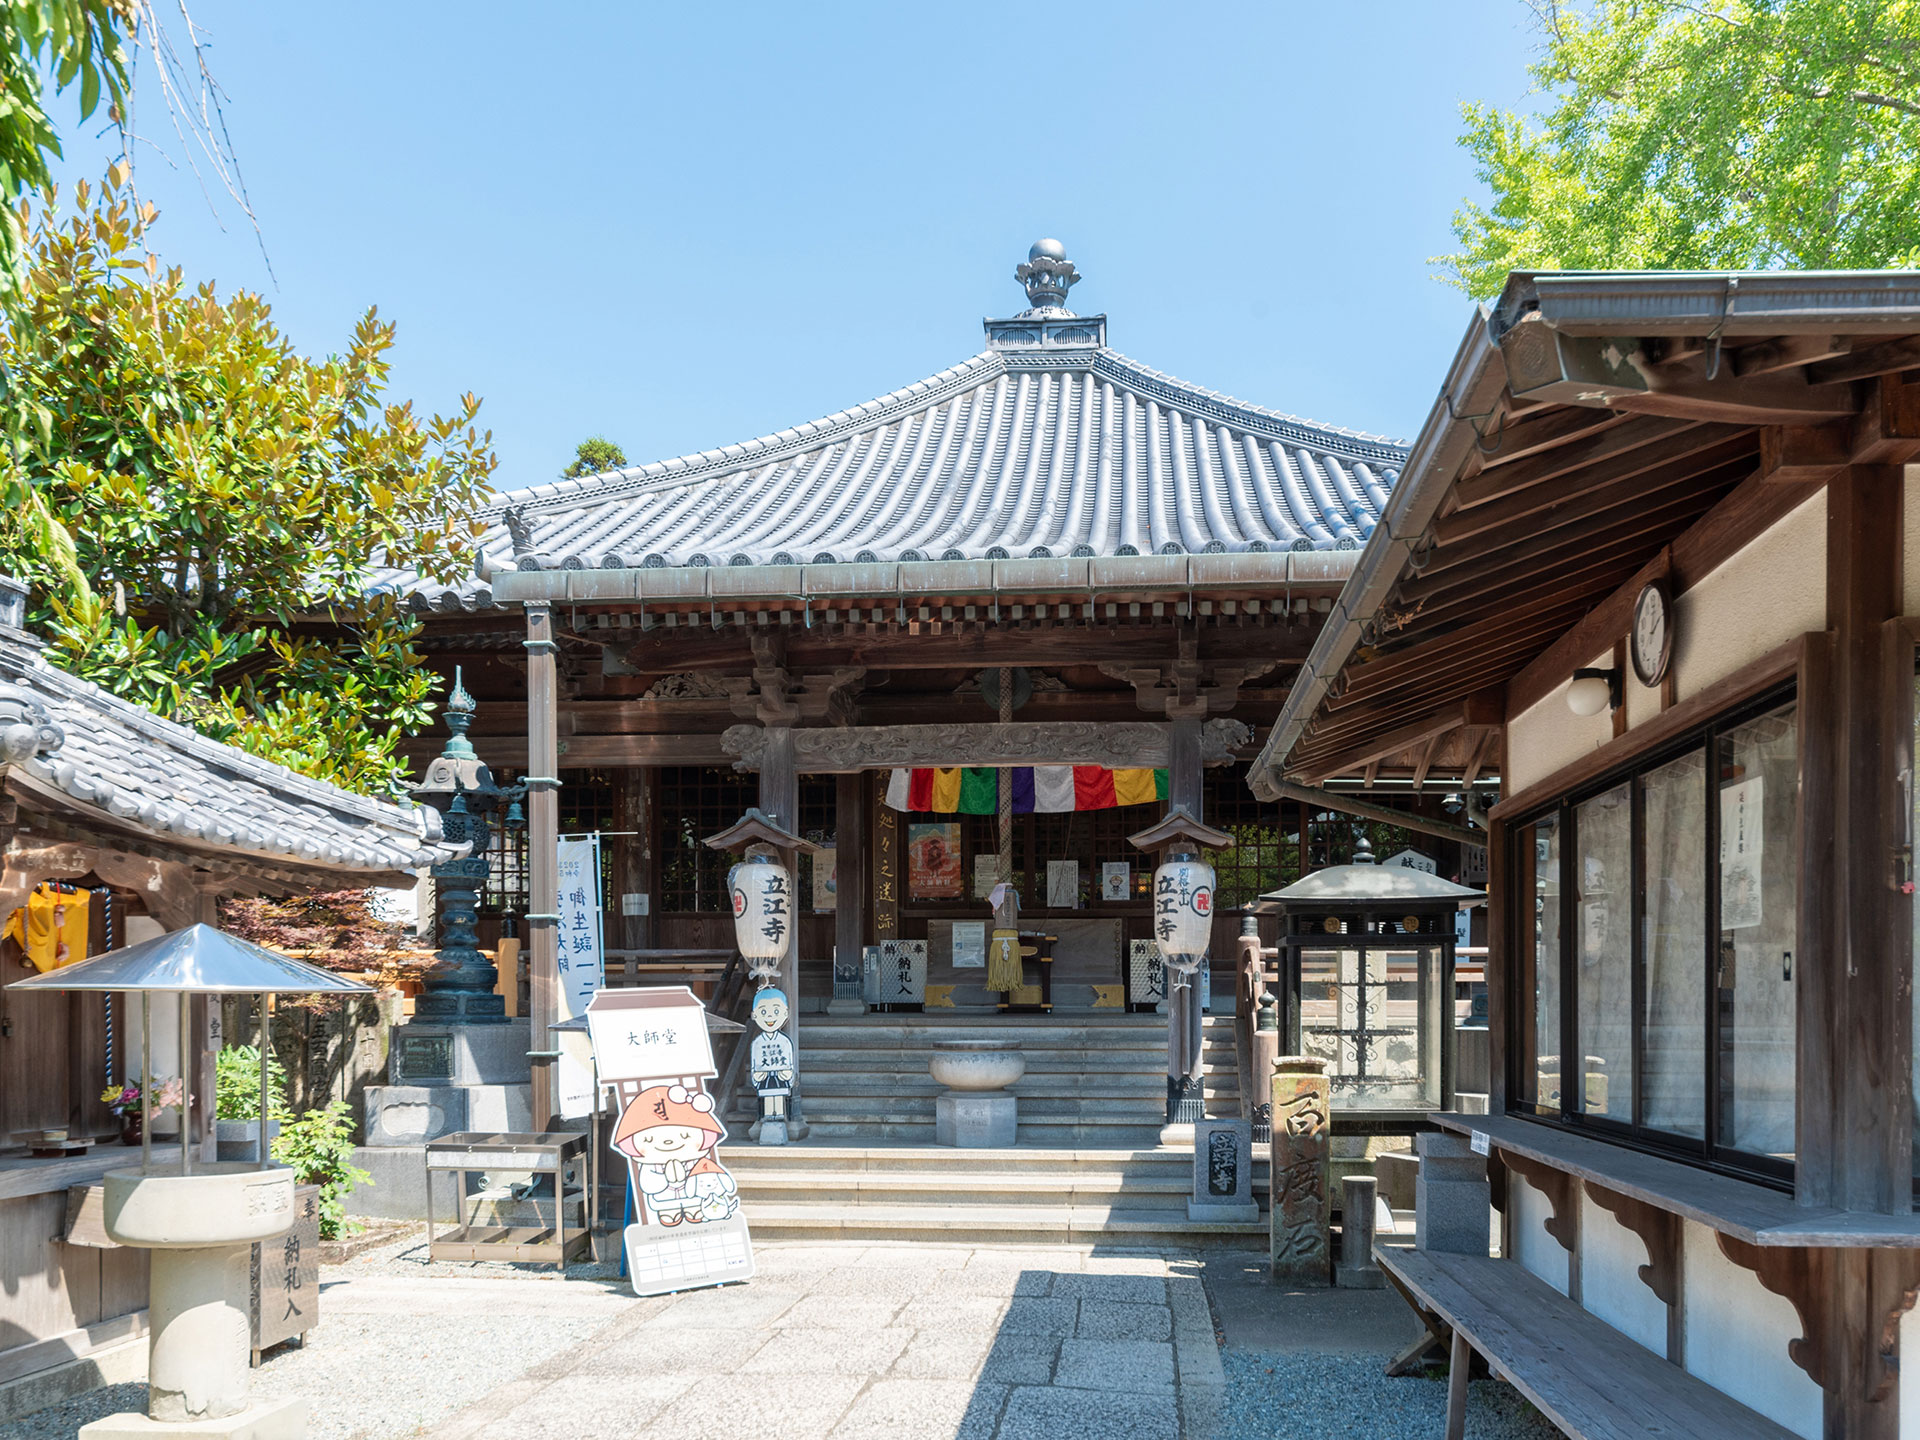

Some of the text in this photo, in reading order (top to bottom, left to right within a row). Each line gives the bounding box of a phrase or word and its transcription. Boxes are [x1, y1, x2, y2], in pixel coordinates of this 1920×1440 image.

[761, 875, 787, 944] 立江寺
[1156, 876, 1178, 942] 立江寺
[897, 957, 913, 995] 納札入
[1147, 958, 1162, 996] 納札入
[627, 1028, 677, 1046] 大師堂
[761, 1056, 788, 1067] 大師堂
[1211, 1133, 1235, 1191] 立江寺
[1278, 1090, 1325, 1260] 百度石
[282, 1234, 302, 1322] 納札入
